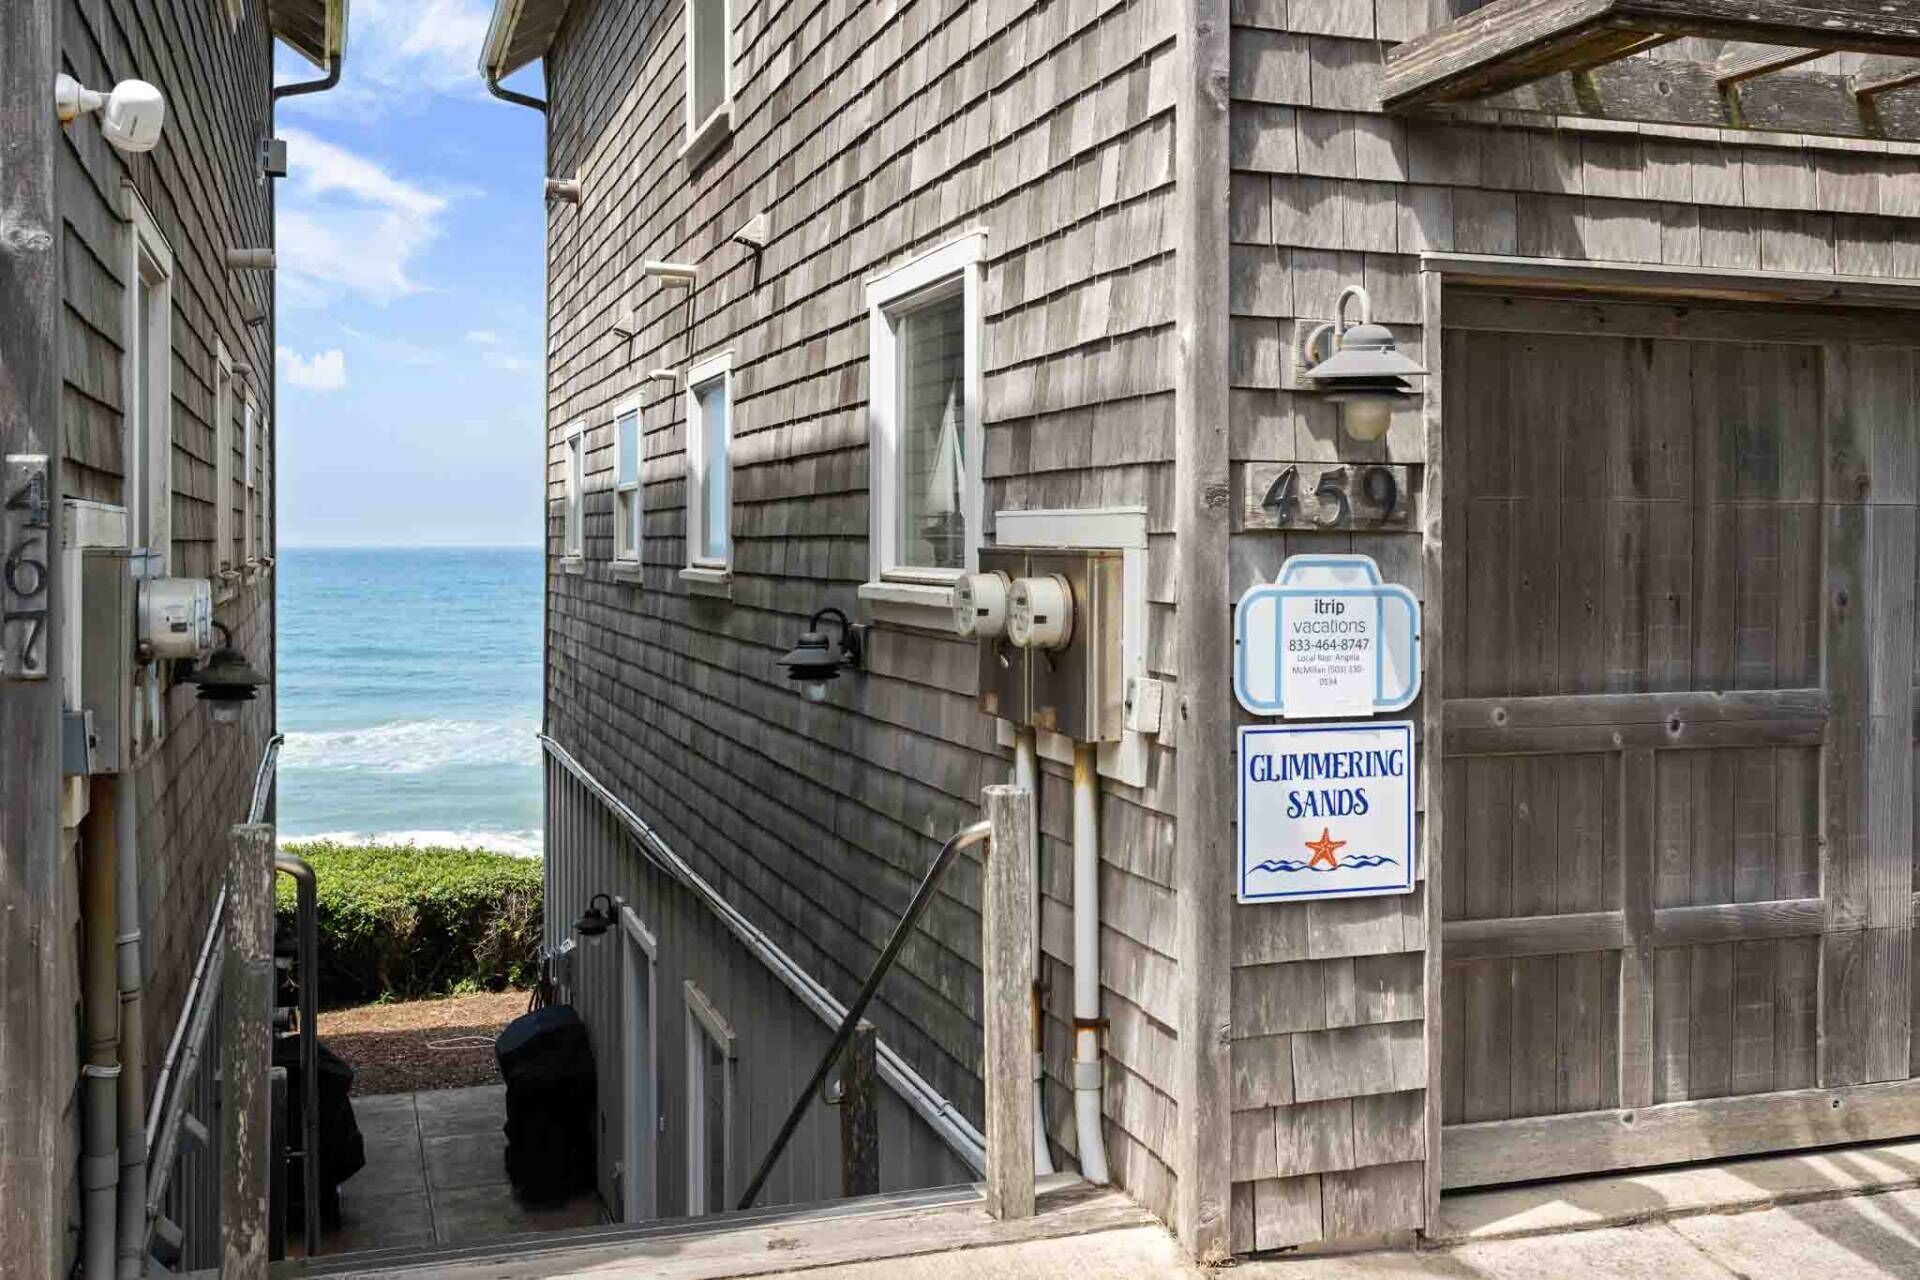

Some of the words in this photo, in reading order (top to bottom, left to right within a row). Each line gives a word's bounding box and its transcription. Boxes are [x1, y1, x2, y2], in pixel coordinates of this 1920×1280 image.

[1261, 464, 1397, 528] 459
[4, 470, 49, 670] 467
[1314, 598, 1345, 615] itrip
[1293, 619, 1366, 634] vacations
[1289, 638, 1370, 652] 833-464-8747
[1297, 653, 1316, 662] Local
[1292, 665, 1326, 674] McMillan
[1249, 749, 1404, 782] GLIMMERING
[1286, 787, 1369, 819] SANDS
